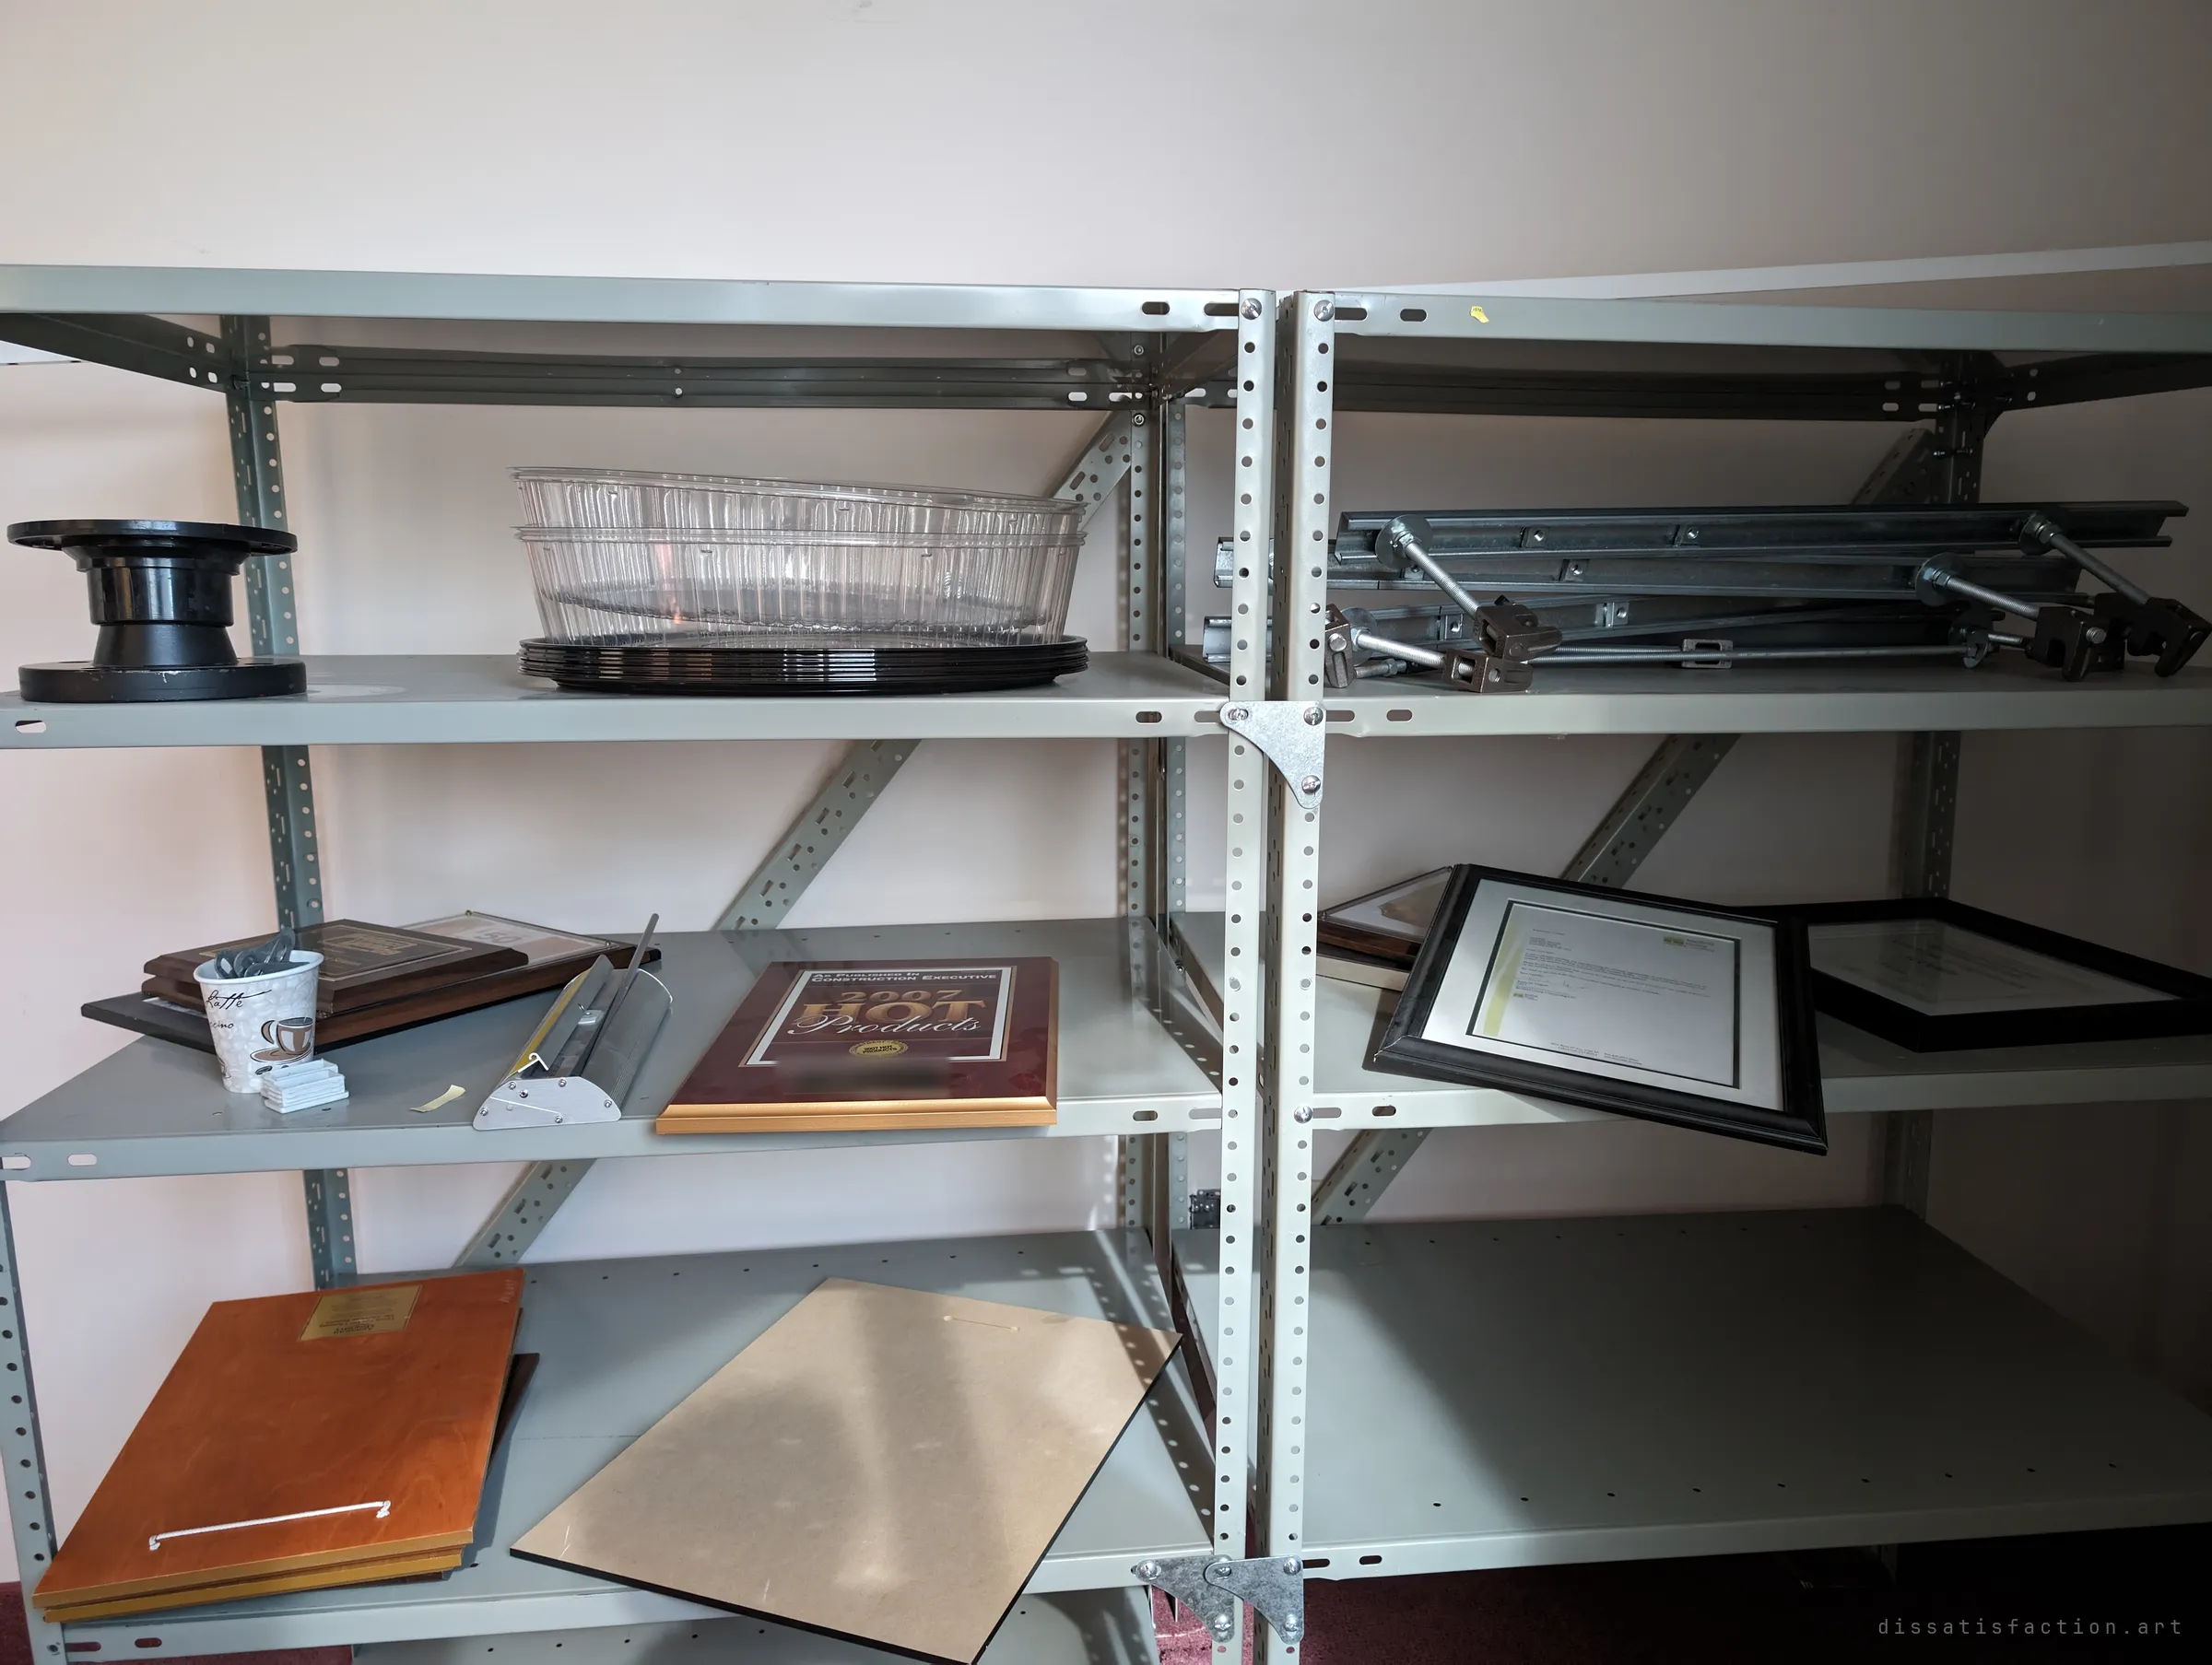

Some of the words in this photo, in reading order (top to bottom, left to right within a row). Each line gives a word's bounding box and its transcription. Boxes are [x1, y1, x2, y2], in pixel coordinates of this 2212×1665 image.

[841, 990, 962, 1003] 2007
[791, 1000, 986, 1025] HOT
[787, 1014, 982, 1035] Products
